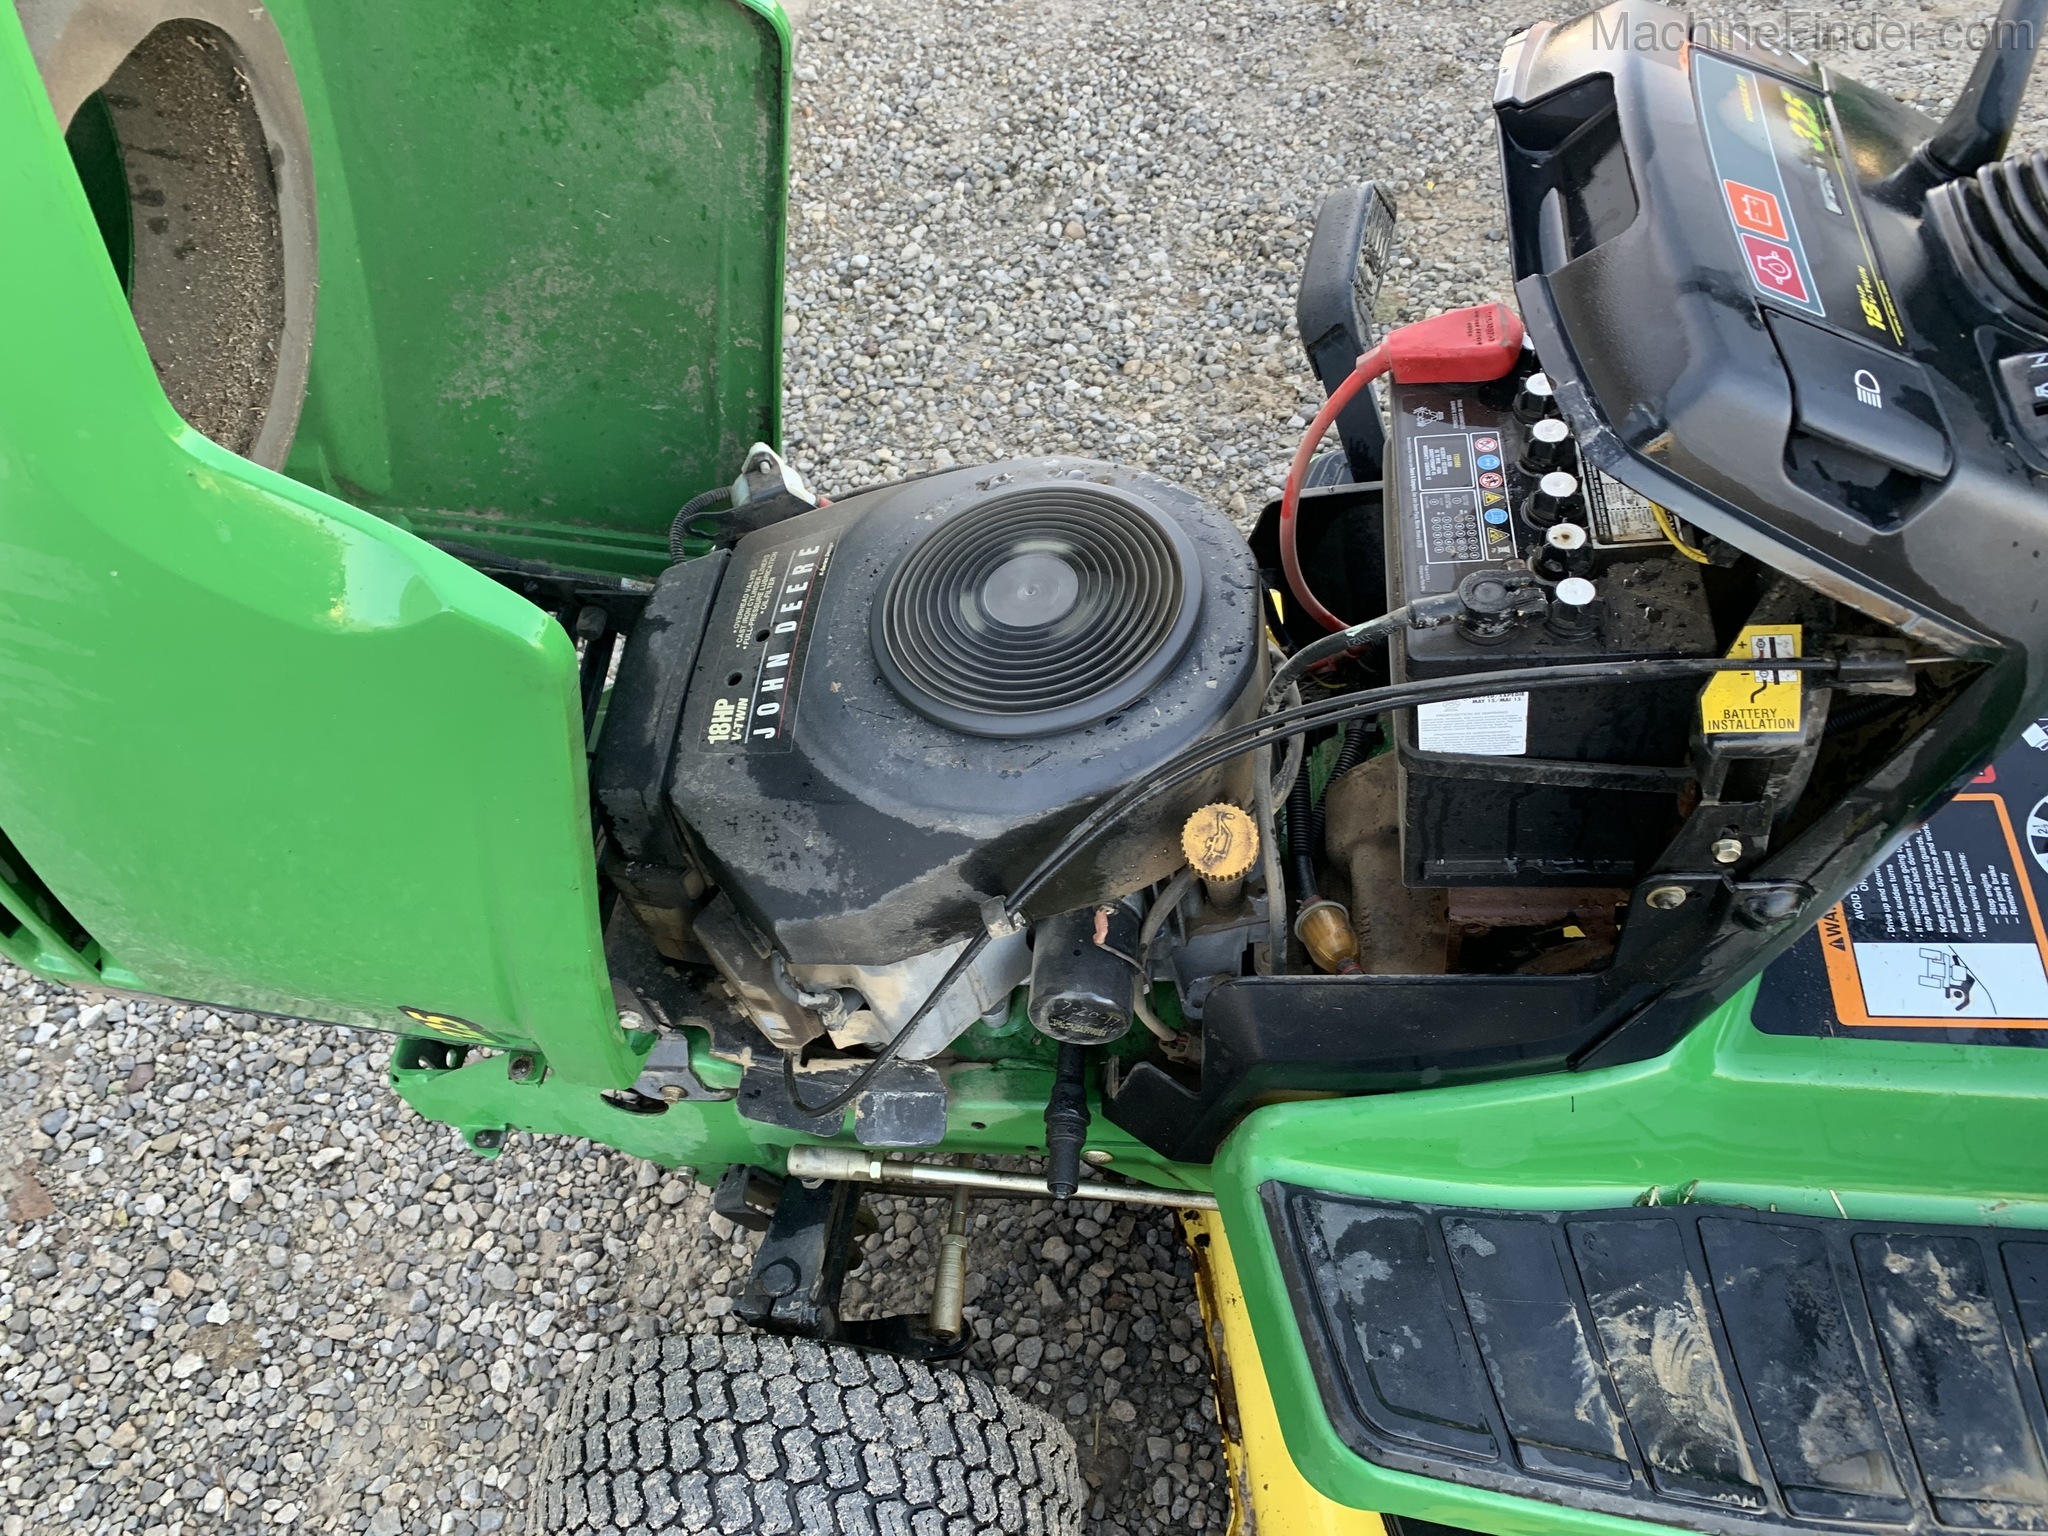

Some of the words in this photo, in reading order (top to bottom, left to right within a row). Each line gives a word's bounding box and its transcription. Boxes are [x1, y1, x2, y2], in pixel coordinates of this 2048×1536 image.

[1780, 86, 1825, 151] 325
[1857, 265, 1877, 304] V-TWIN
[1860, 297, 1886, 330] 18
[743, 592, 764, 645] FULL-PRESSURE
[760, 551, 778, 590] LUBRICATION
[763, 577, 776, 598] FILTER
[733, 594, 749, 628] OVERHEAD
[745, 569, 758, 592] VALVES
[736, 625, 746, 643] CAST
[741, 608, 751, 623] IRON
[747, 576, 762, 606] CYLINDER
[758, 554, 770, 575] LINERS
[761, 600, 769, 610] OIL
[753, 652, 791, 740] JOHN
[775, 544, 820, 634] DEERE
[707, 698, 736, 744] 18HP
[731, 697, 749, 741] V-TWIN
[1708, 718, 1795, 730] INSTALLATION
[1723, 708, 1777, 719] BATTERY
[1905, 848, 1916, 865] down
[1916, 835, 1930, 862] (guards,
[1926, 842, 1937, 855] and
[1886, 864, 1898, 882] turns
[1897, 854, 1910, 873] going
[1931, 857, 1945, 875] place
[1942, 850, 1957, 876] manual
[1958, 852, 1973, 884] machine:
[1901, 875, 1914, 894] stops
[1909, 867, 1920, 882] back
[1923, 863, 1936, 890] devices
[1980, 873, 1994, 897] engine
[1988, 864, 1999, 885] brake
[2000, 873, 2010, 885] key
[1878, 889, 1888, 902] and
[1889, 883, 1904, 909] sudden
[1915, 883, 1924, 895] and
[1951, 877, 1968, 913] operator's
[1966, 885, 1981, 911] leaving
[1993, 886, 2005, 902] park
[1851, 894, 1866, 920] AVOID
[1882, 903, 1891, 912] up
[1907, 895, 1922, 926] machine
[1918, 897, 1930, 915] blade
[1931, 891, 1943, 913] safety
[1938, 884, 1955, 918] switches)
[1988, 899, 1999, 915] Stop
[1999, 903, 2009, 915] Set
[2005, 886, 2019, 915] Remove
[1885, 914, 1896, 933] Drive
[1897, 911, 1910, 932] Avoid
[1922, 917, 1933, 931] stop
[1937, 914, 1949, 933] Keep
[1948, 919, 1959, 933] and
[1962, 914, 1973, 933] Read
[1975, 912, 1987, 933] When
[1062, 1000, 1121, 1026] 7-20-17
